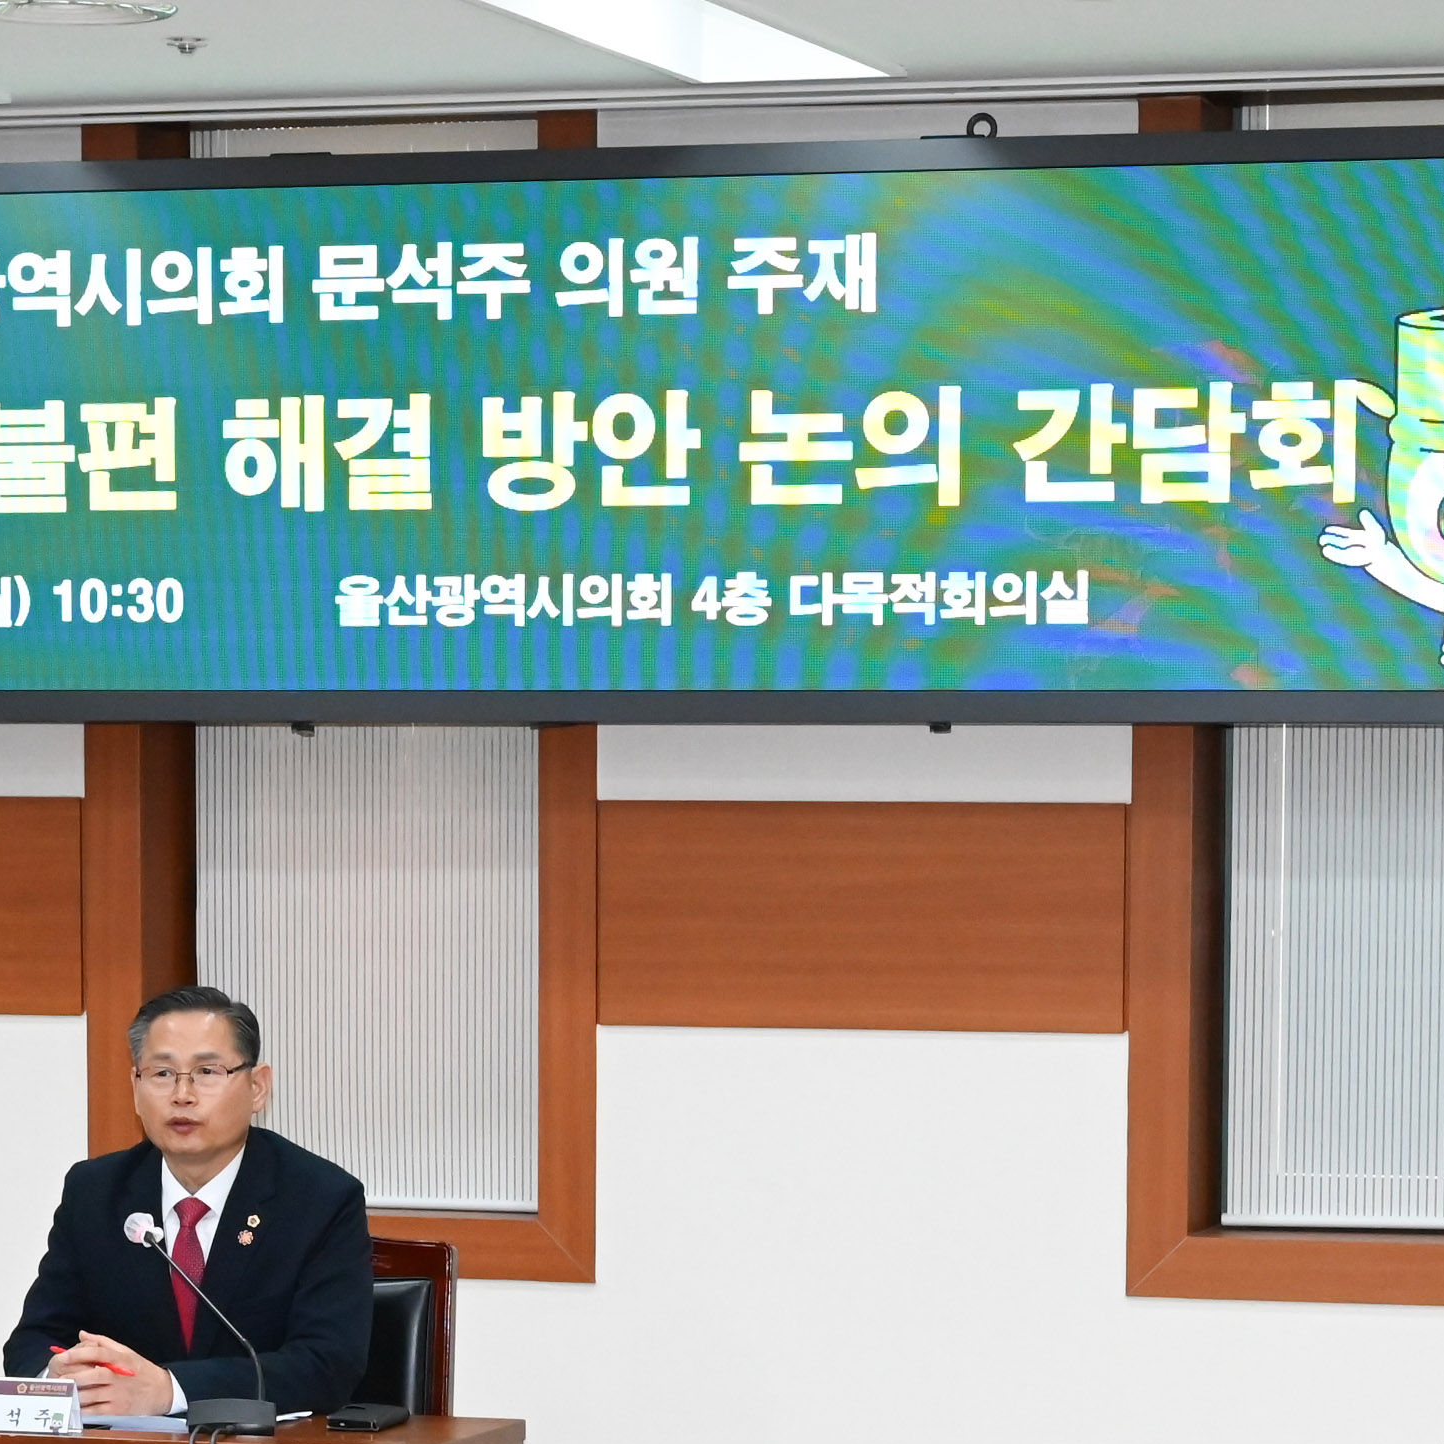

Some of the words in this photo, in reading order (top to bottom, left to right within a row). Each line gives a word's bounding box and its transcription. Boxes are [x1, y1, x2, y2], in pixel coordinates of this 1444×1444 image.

[312, 241, 531, 321] 문석주
[554, 236, 699, 318] 의원
[727, 232, 877, 315] 주재
[222, 393, 433, 512] 해결
[482, 389, 702, 512] 방안
[739, 385, 962, 507] 논의
[1012, 379, 1357, 504] 간담회
[53, 577, 184, 623] 10:30
[335, 573, 672, 627] 울산광역시의회
[691, 571, 772, 626] 4층
[789, 569, 1089, 626] 다목적회의실
